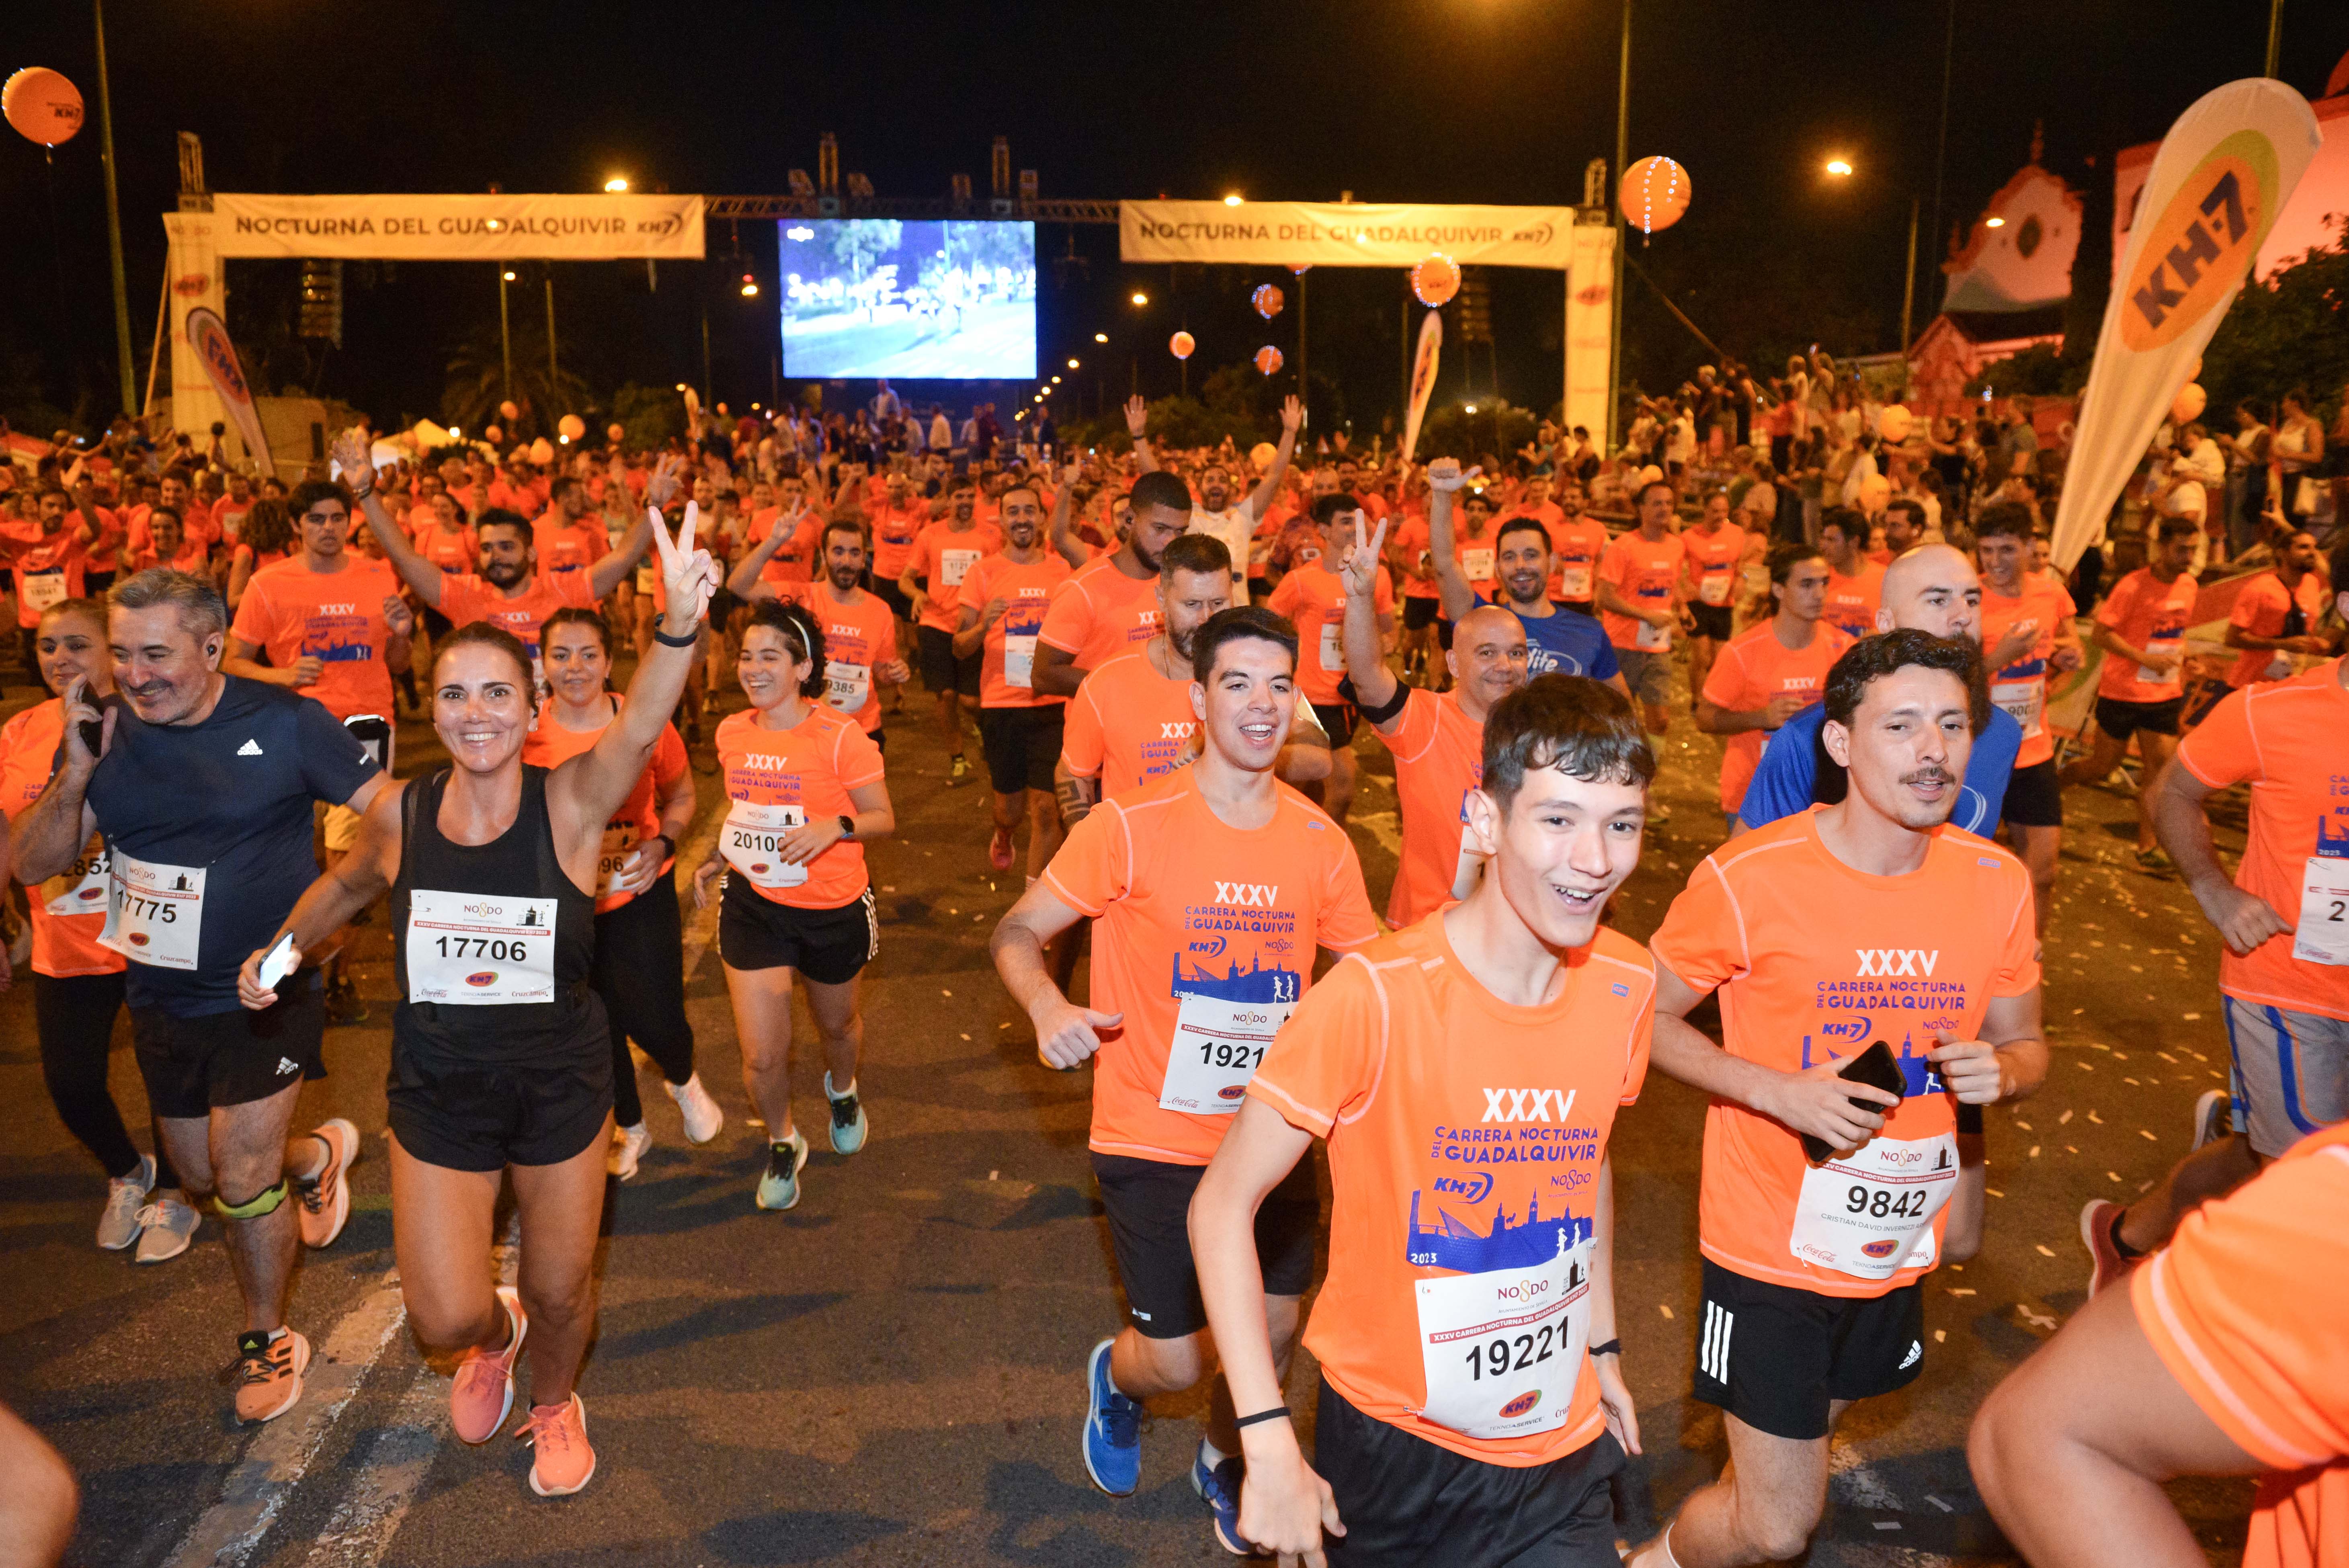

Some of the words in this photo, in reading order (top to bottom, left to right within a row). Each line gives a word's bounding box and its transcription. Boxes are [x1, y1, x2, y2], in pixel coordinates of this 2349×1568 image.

[236, 217, 375, 235] NOCTURNA
[383, 219, 430, 235] DEL
[438, 217, 625, 237] GUADALQUIVIR
[1140, 223, 1269, 240] NOCTURNA
[1279, 225, 1323, 240] DEL
[1330, 226, 1502, 245] GUADALQUIVIR
[1019, 588, 1046, 597] XXXV
[320, 604, 355, 616] XXXV
[831, 624, 861, 637] XXXV
[1783, 677, 1816, 690] XXXV
[1140, 740, 1180, 748] CARRERA
[744, 753, 787, 771] XXXV
[731, 777, 800, 790] GUADALQUIVIR
[759, 772, 801, 781] NOCTURNA
[1214, 881, 1278, 907] XXXV
[118, 890, 176, 923] 17775
[1185, 906, 1237, 917] CARRERA
[1242, 910, 1295, 920] NOCTURNA
[1193, 918, 1294, 933] GUADALQUIVIR
[436, 935, 527, 962] 17706
[160, 954, 191, 964] Cruzcampo
[1856, 949, 1938, 977] XXXV
[1817, 981, 1884, 992] CARRERA
[1889, 981, 1966, 993] NOCTURNA
[1828, 995, 1965, 1010] GUADALQUIVIR
[1481, 1088, 1576, 1123] XXXV
[1435, 1126, 1513, 1142] CARRERA
[1519, 1127, 1598, 1141] NOCTURNA
[1431, 1140, 1442, 1158] DEL
[1445, 1144, 1597, 1164] GUADALQUIVIR
[1835, 1166, 1863, 1177] CARRERA
[1863, 1172, 1896, 1183] NOCTURNA
[1846, 1185, 1927, 1218] 9842
[1821, 1213, 1857, 1227] CRISTIAN
[1858, 1221, 1882, 1231] DAVID
[1884, 1224, 1915, 1232] INVERNIZZI
[1410, 1253, 1437, 1265] 2023
[1434, 1332, 1455, 1341] XXXV
[1455, 1327, 1486, 1338] CARRERA
[1486, 1318, 1523, 1330] NOCTURNA
[1535, 1298, 1570, 1319] GUADALQUIVIR
[1570, 1291, 1578, 1302] KH7
[1578, 1285, 1587, 1296] 2023
[1466, 1315, 1568, 1381] 19221
